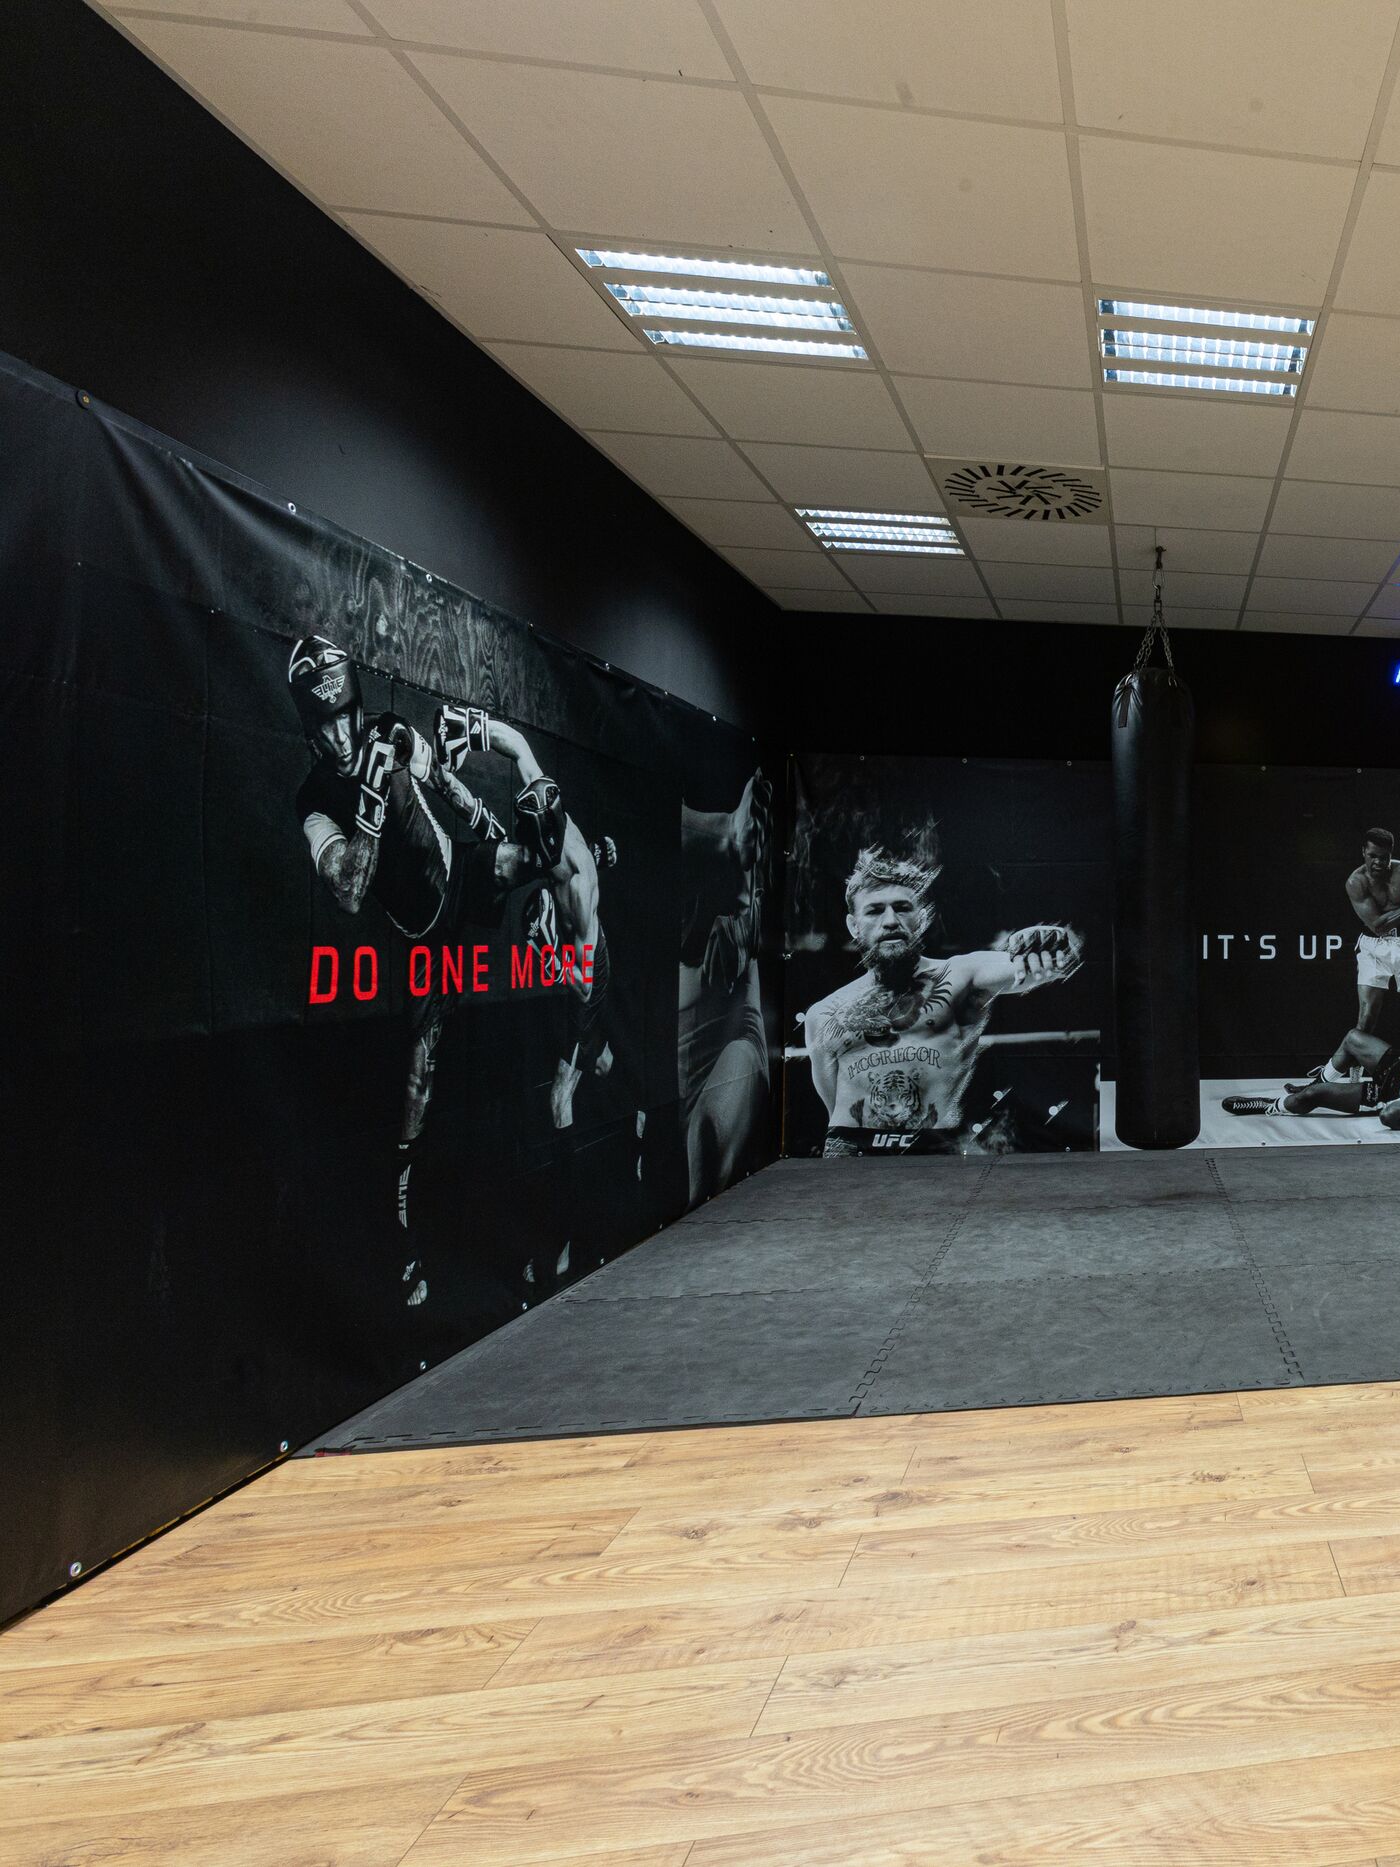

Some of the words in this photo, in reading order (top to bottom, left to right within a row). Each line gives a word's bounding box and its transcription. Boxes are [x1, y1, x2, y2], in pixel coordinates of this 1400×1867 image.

[1299, 934, 1343, 960] UP
[309, 945, 379, 1004] DO
[409, 944, 489, 997] ONE
[511, 944, 594, 990] MORE
[872, 1133, 915, 1148] UFC
